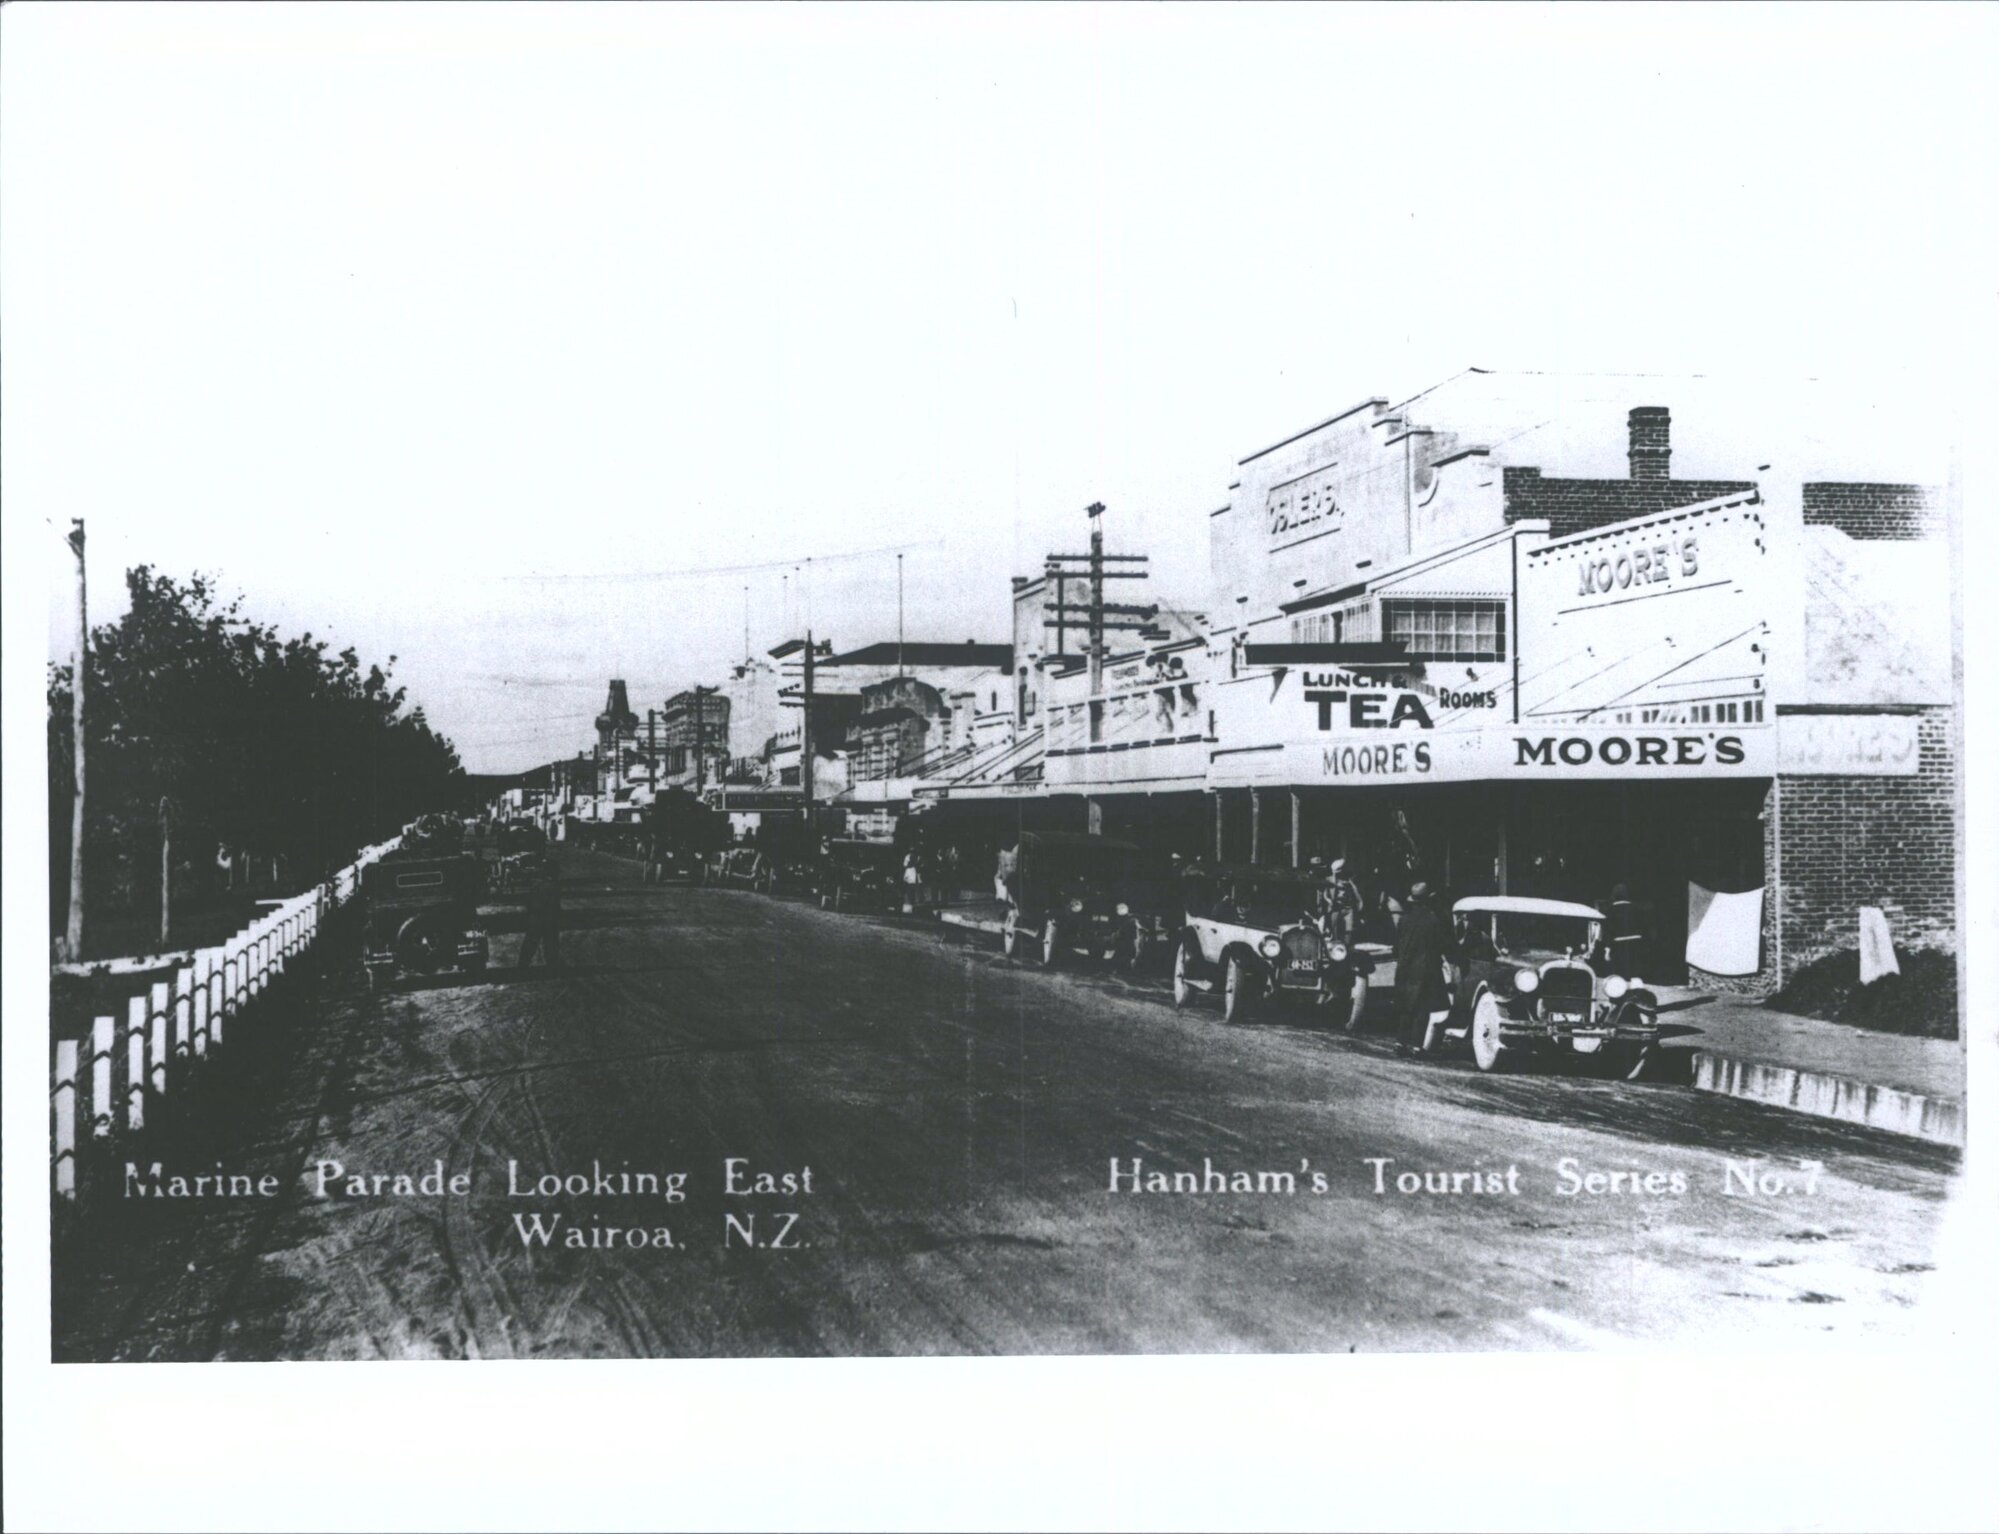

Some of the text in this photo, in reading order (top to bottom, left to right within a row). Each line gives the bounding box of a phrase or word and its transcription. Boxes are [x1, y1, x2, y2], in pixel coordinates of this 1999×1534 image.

[1577, 537, 1699, 597] MOORE'S
[1305, 690, 1435, 731] TEA
[1439, 687, 1497, 709] ROOMS
[1322, 740, 1432, 776] MOORE'S
[1513, 732, 1745, 766] MOORE'S
